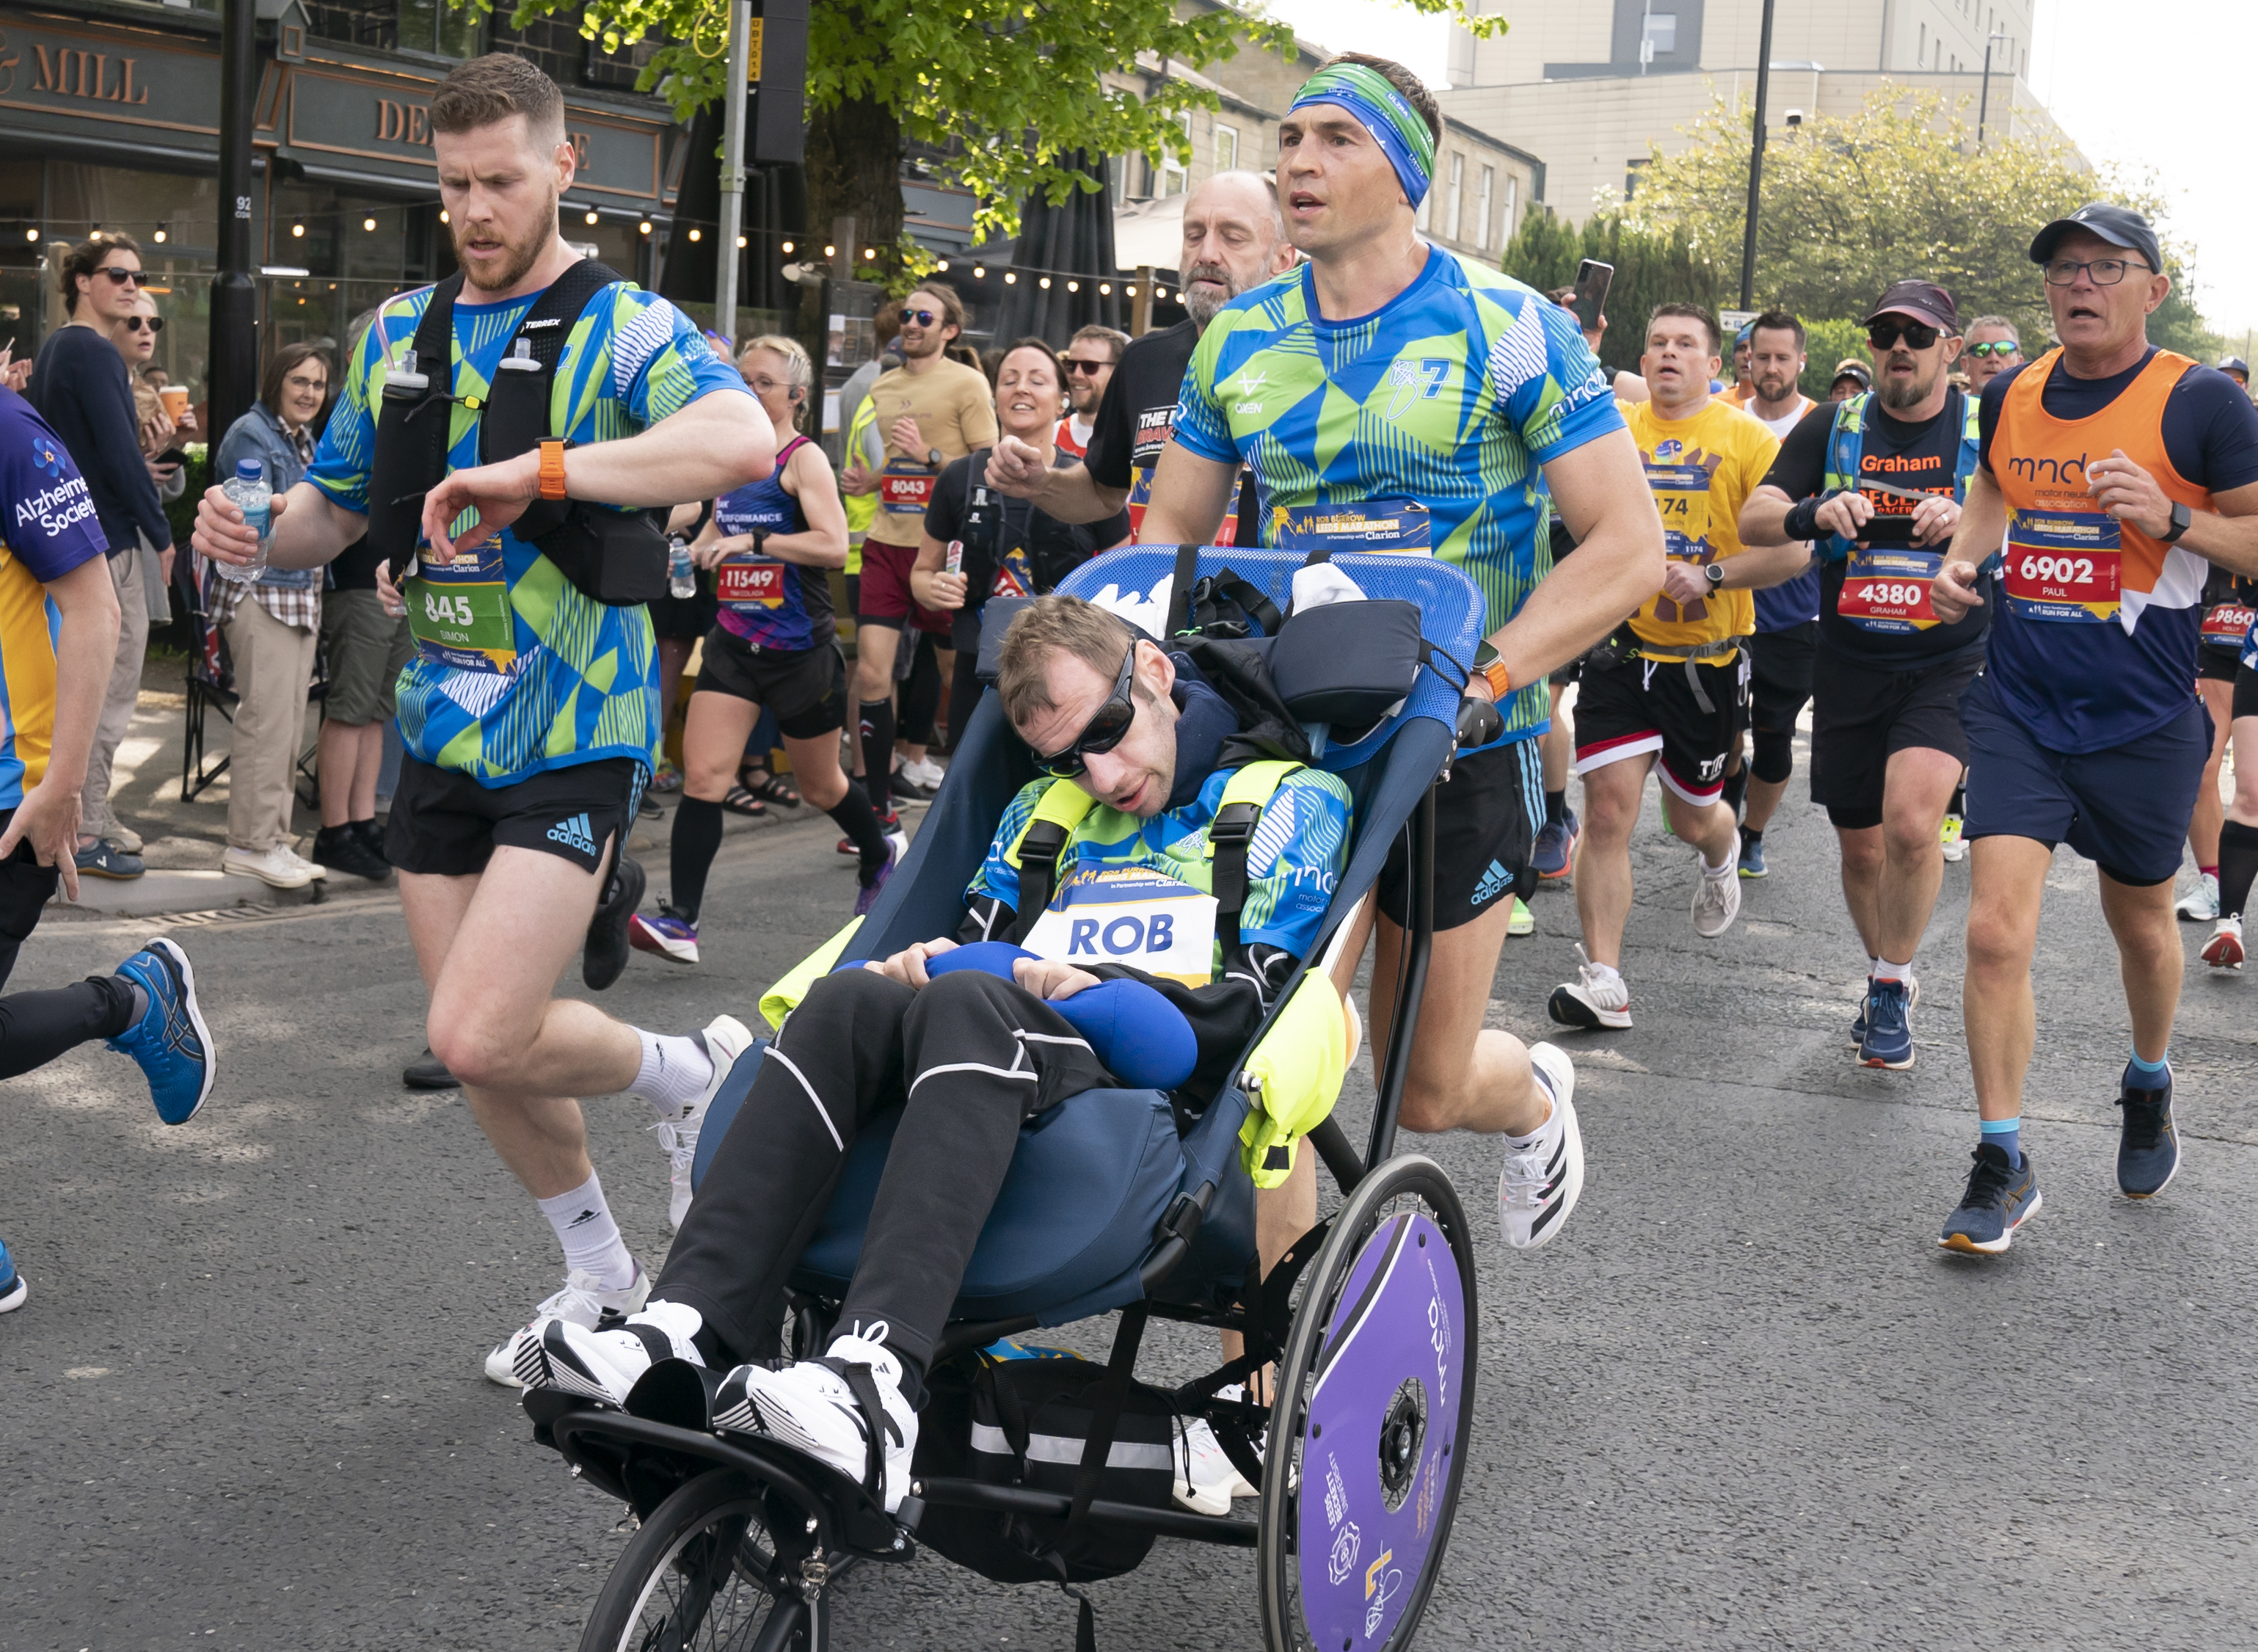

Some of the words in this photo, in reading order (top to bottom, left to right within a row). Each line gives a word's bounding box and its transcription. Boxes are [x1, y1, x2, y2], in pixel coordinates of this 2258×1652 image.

[32, 44, 148, 104] MILL
[525, 319, 561, 329] TERREX
[1140, 412, 1167, 429] THE
[1861, 455, 1941, 472] Graham
[891, 479, 925, 495] 8043
[2034, 499, 2088, 509] association
[1316, 523, 1339, 531] LEEDS
[1341, 520, 1399, 531] MARATHON
[1365, 531, 1400, 540] Clarion
[453, 564, 481, 572] Clarion
[2020, 555, 2094, 583] 6902
[726, 570, 773, 588] 11549
[1858, 583, 1921, 605] 4380
[2042, 586, 2067, 597] PAUL
[425, 592, 473, 626] 845
[1870, 607, 1906, 615] GRAHAM
[2215, 609, 2255, 625] 9860
[440, 630, 470, 643] SIMON
[547, 829, 597, 856] adidas
[1471, 873, 1515, 905] adidas
[1068, 914, 1174, 956] ROB
[1328, 1451, 1349, 1514] UNIVERSITY
[1325, 1471, 1343, 1523] BECKETT
[1324, 1493, 1337, 1532] LEEDS
